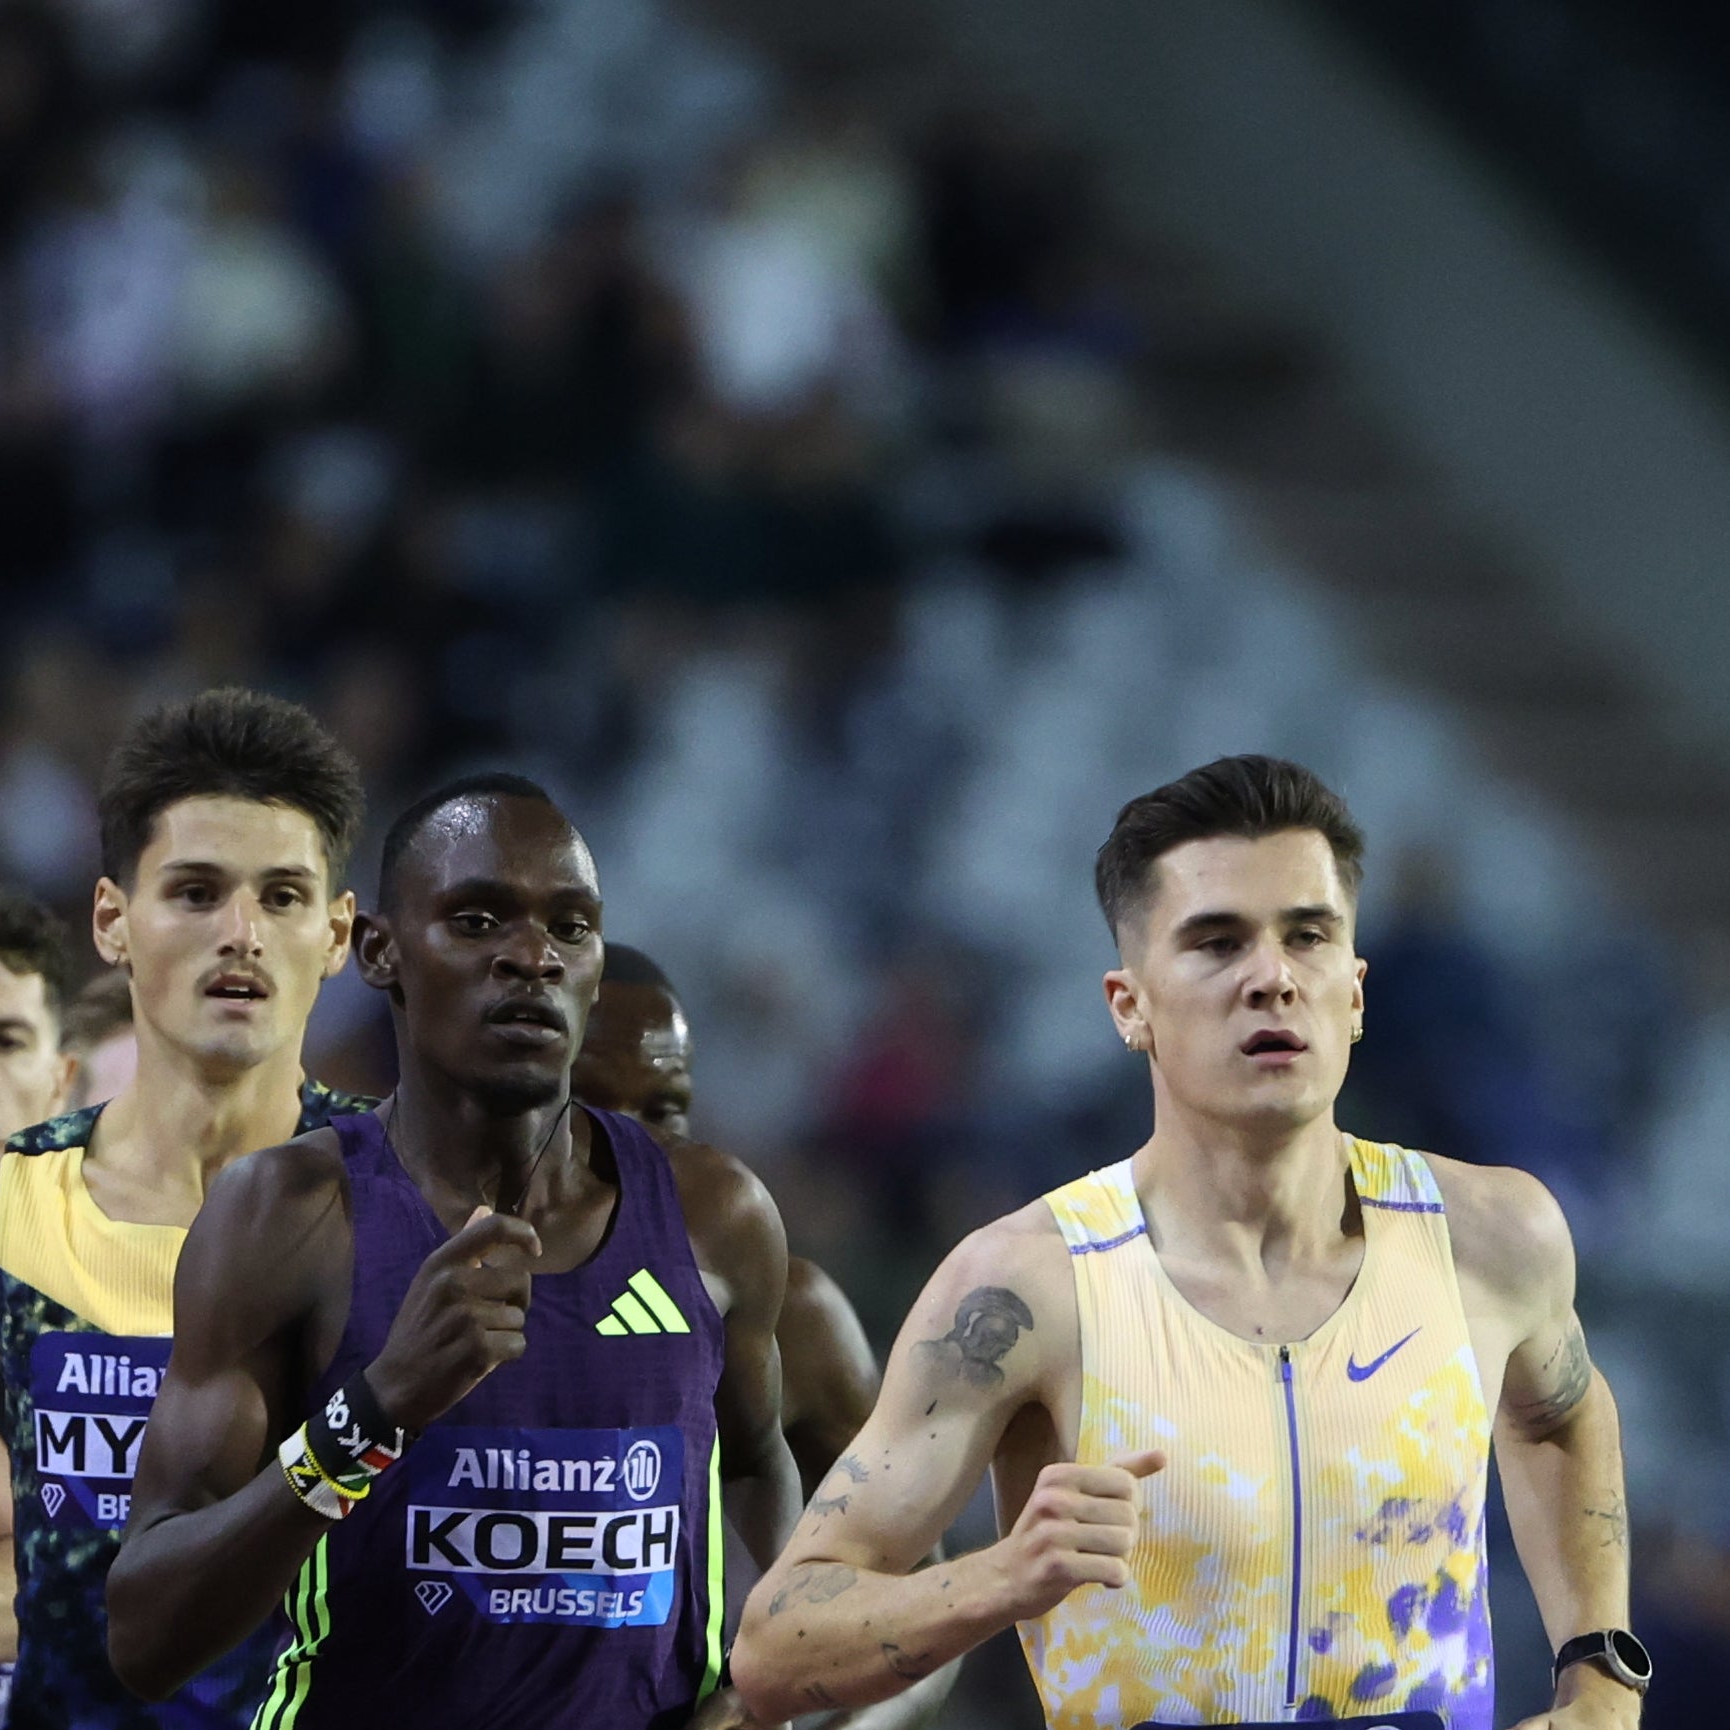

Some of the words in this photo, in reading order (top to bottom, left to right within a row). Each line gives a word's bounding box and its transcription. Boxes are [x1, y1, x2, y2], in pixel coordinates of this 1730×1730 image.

[447, 1448, 616, 1492] Allianz
[413, 1510, 674, 1570] KOECH
[489, 1588, 644, 1618] BRUSSELS
